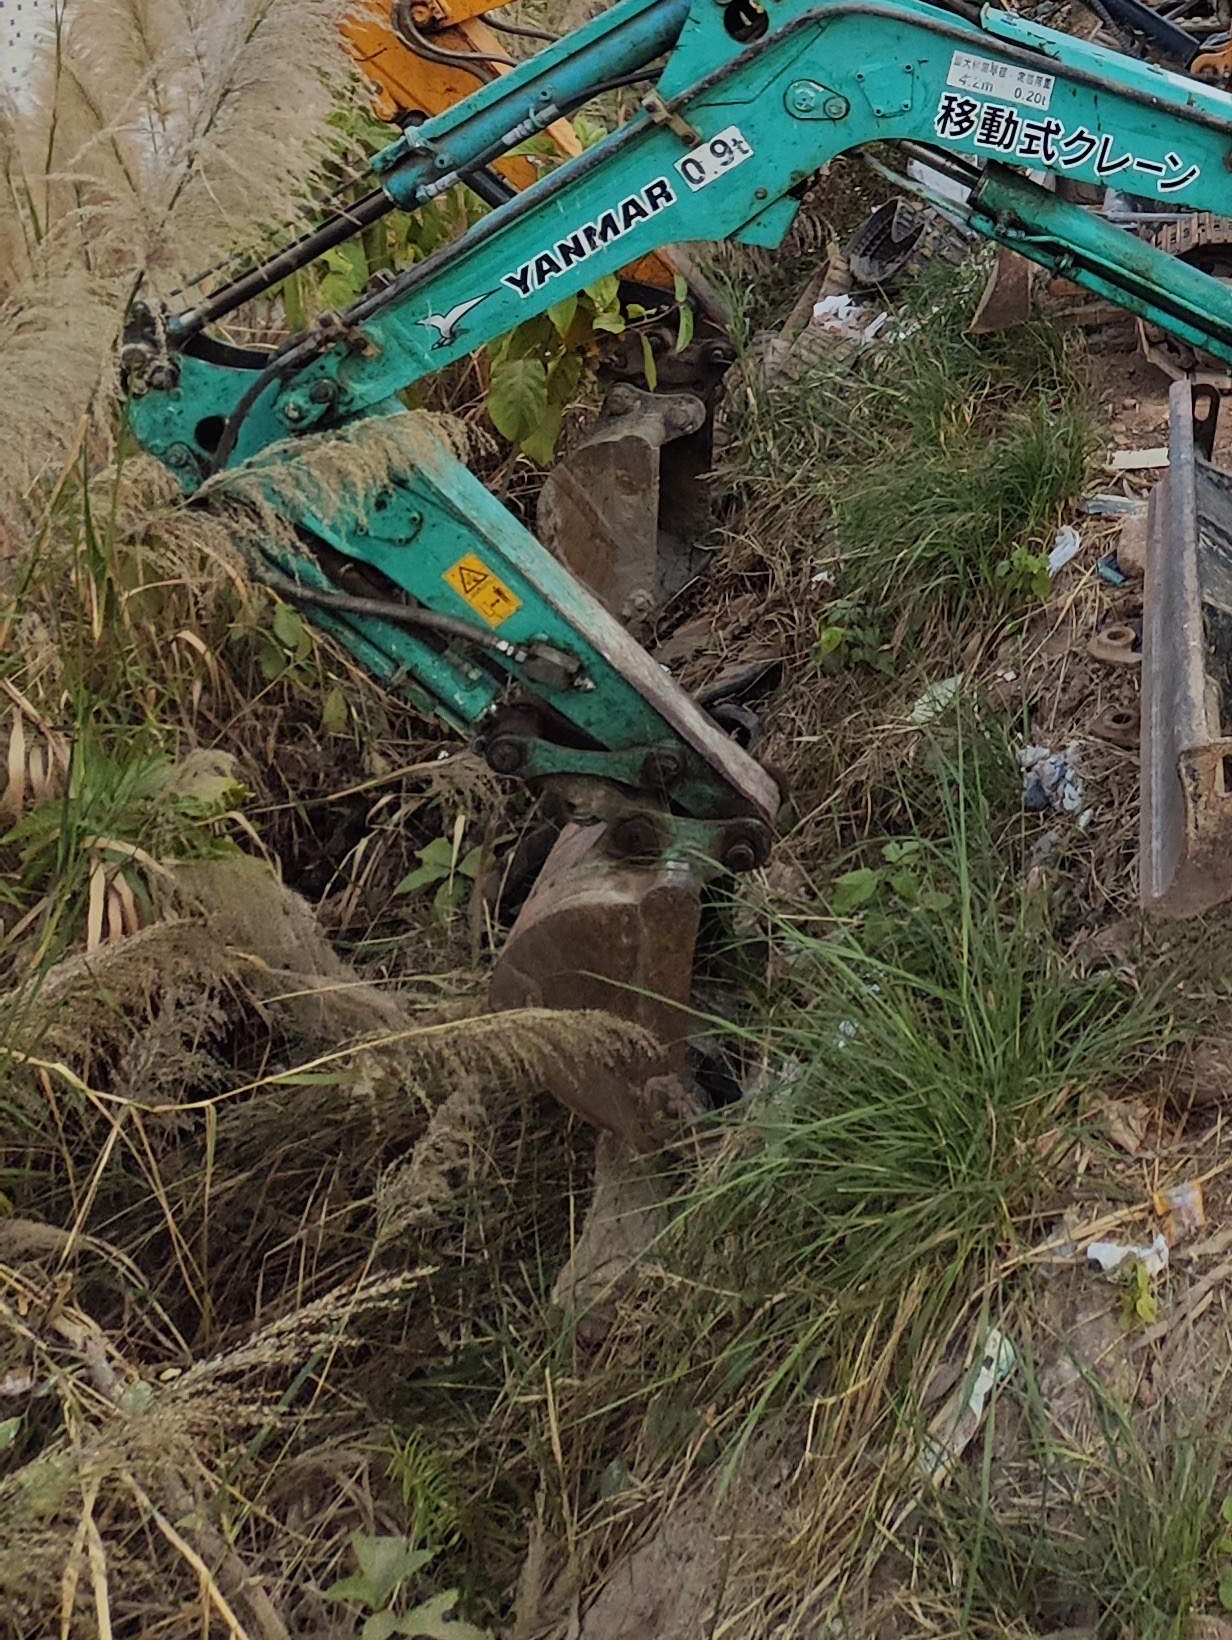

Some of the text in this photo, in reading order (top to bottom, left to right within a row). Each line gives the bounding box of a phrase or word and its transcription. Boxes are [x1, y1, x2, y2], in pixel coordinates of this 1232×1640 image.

[936, 94, 1199, 191] 移動式クレーン
[503, 179, 676, 297] YANMAR
